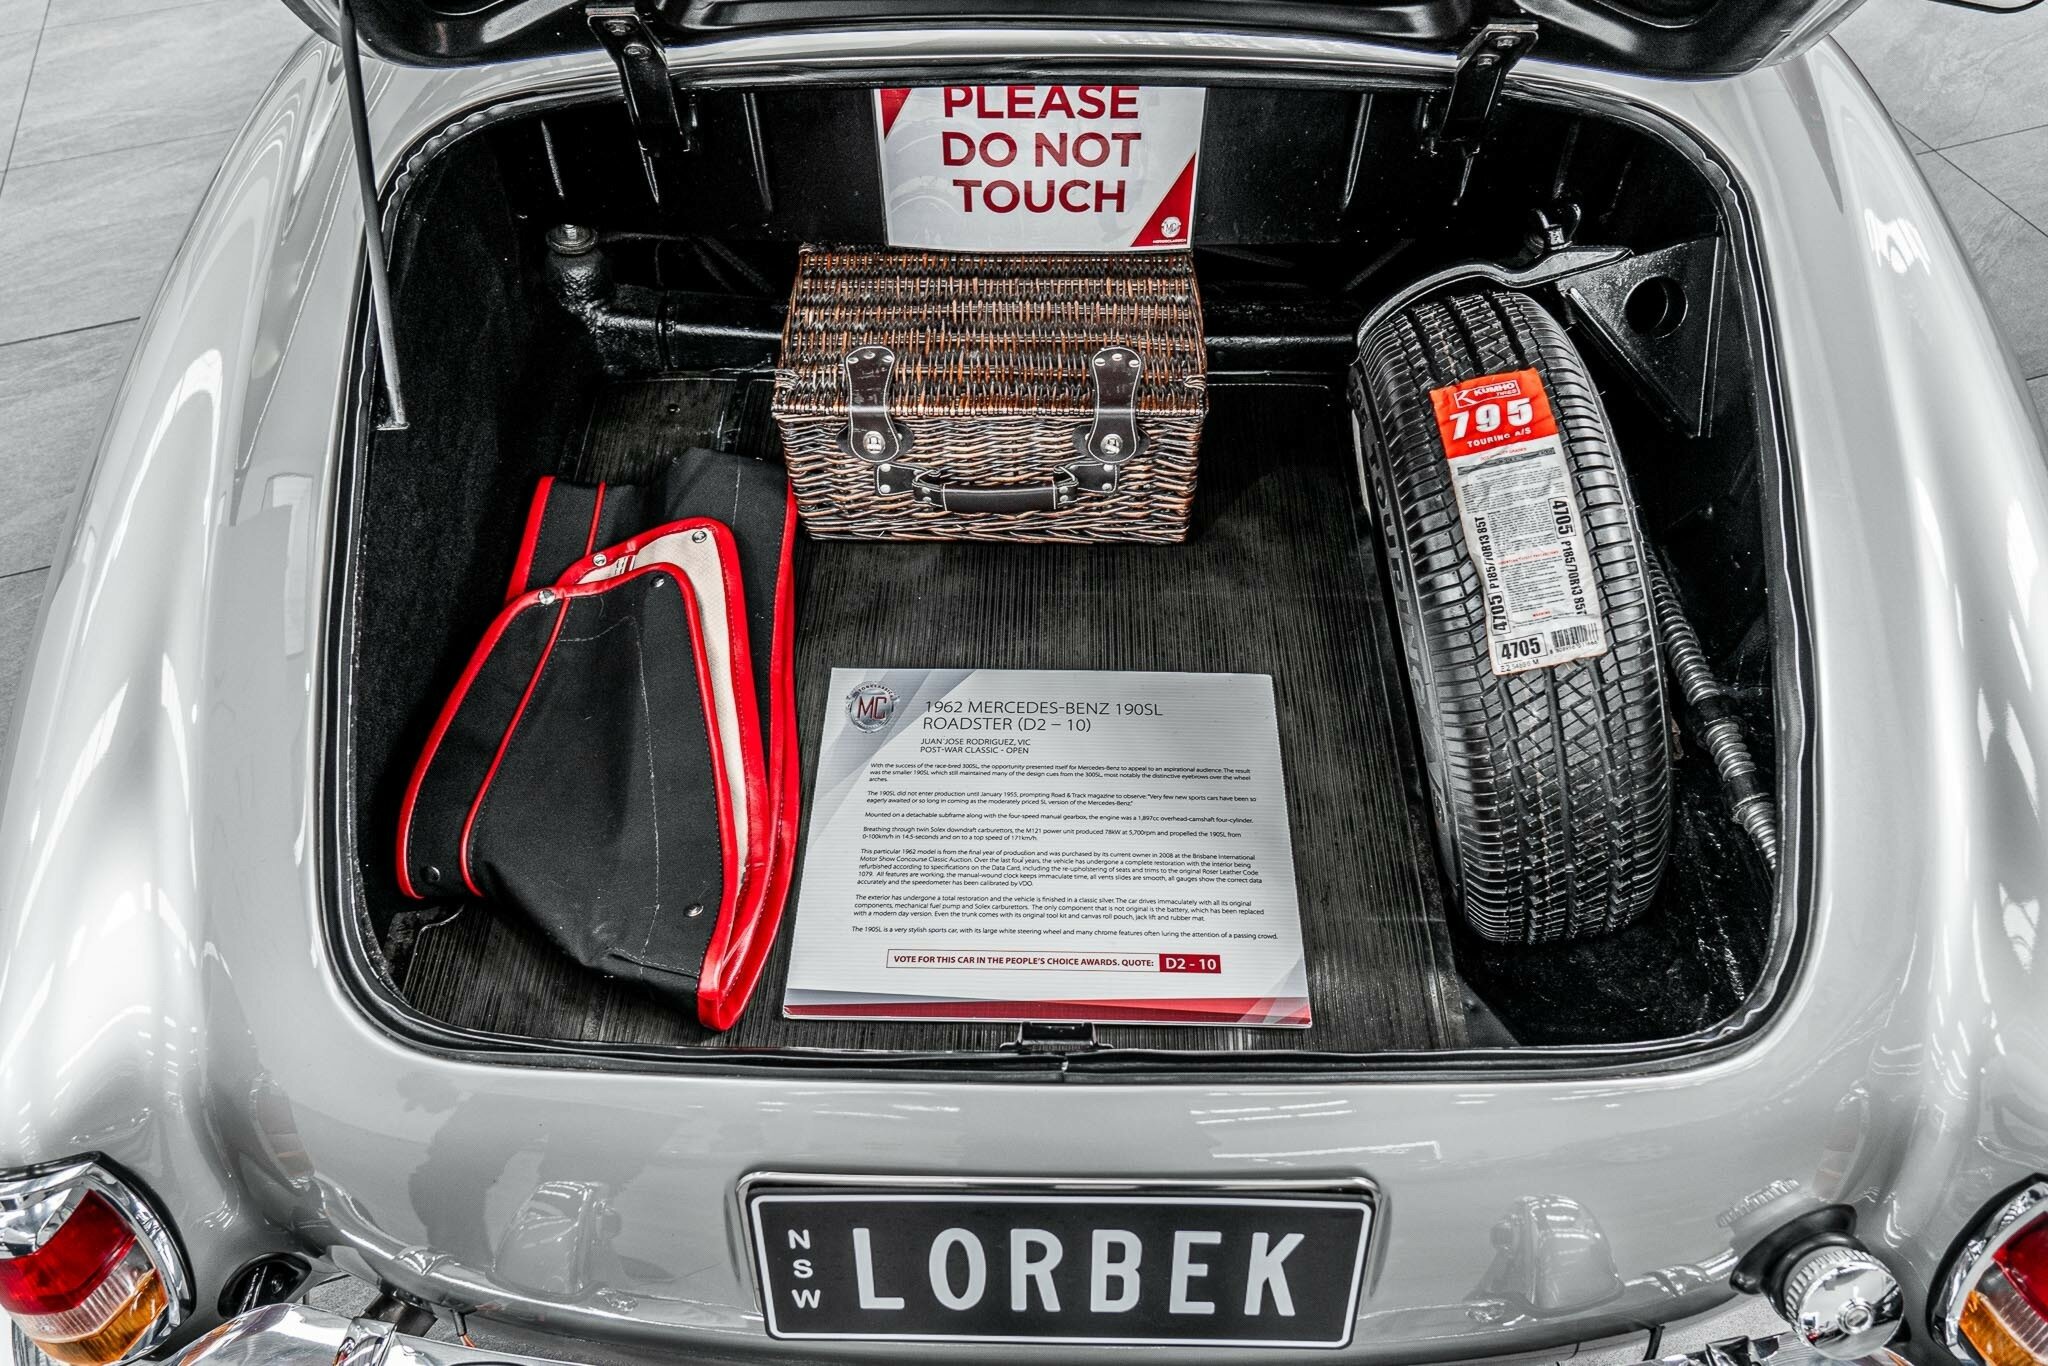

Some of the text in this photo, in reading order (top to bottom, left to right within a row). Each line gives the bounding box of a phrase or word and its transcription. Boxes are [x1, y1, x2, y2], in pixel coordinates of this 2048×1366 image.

[943, 86, 1140, 119] PLEASE
[942, 131, 1142, 168] DO NOT
[953, 179, 1126, 214] TOUCH
[1474, 381, 1515, 396] KUMHO
[1450, 398, 1533, 440] 795
[1467, 427, 1532, 448] TOURING A/S
[1474, 517, 1487, 534] 85T
[1552, 500, 1573, 535] 4705
[1561, 541, 1583, 596] P185/70R13
[1489, 595, 1508, 631] 4705
[1501, 638, 1541, 660] 4705
[857, 695, 887, 721] MC
[925, 700, 1162, 716] 1962 MERCEDES-BENZ 190SL
[923, 716, 1012, 730] ROADSTER
[1017, 716, 1046, 731] (D2
[1067, 717, 1091, 732] 10)
[942, 737, 964, 745] JOSE
[966, 738, 1016, 746] RODRIGUEZ,
[1017, 738, 1031, 746] VIC
[964, 746, 998, 754] CLASSIC
[1005, 746, 1029, 754] OPEN
[1215, 816, 1253, 824] four-cylinder.
[908, 926, 927, 934] stylish
[982, 927, 997, 935] large
[1161, 930, 1179, 938] luring
[893, 955, 916, 963] VOTE
[917, 955, 935, 963] FOR
[976, 956, 986, 964] IN
[987, 956, 1004, 964] THE
[1005, 957, 1045, 965] PEOPLE’S
[1046, 957, 1079, 965] CHOICE
[1080, 958, 1120, 966] AWARDS.
[1121, 959, 1154, 967] QUOTE:
[1165, 957, 1186, 970] D2
[1198, 958, 1217, 971] 10
[788, 1229, 821, 1310] NSW
[851, 1226, 1306, 1317] LORBEK
